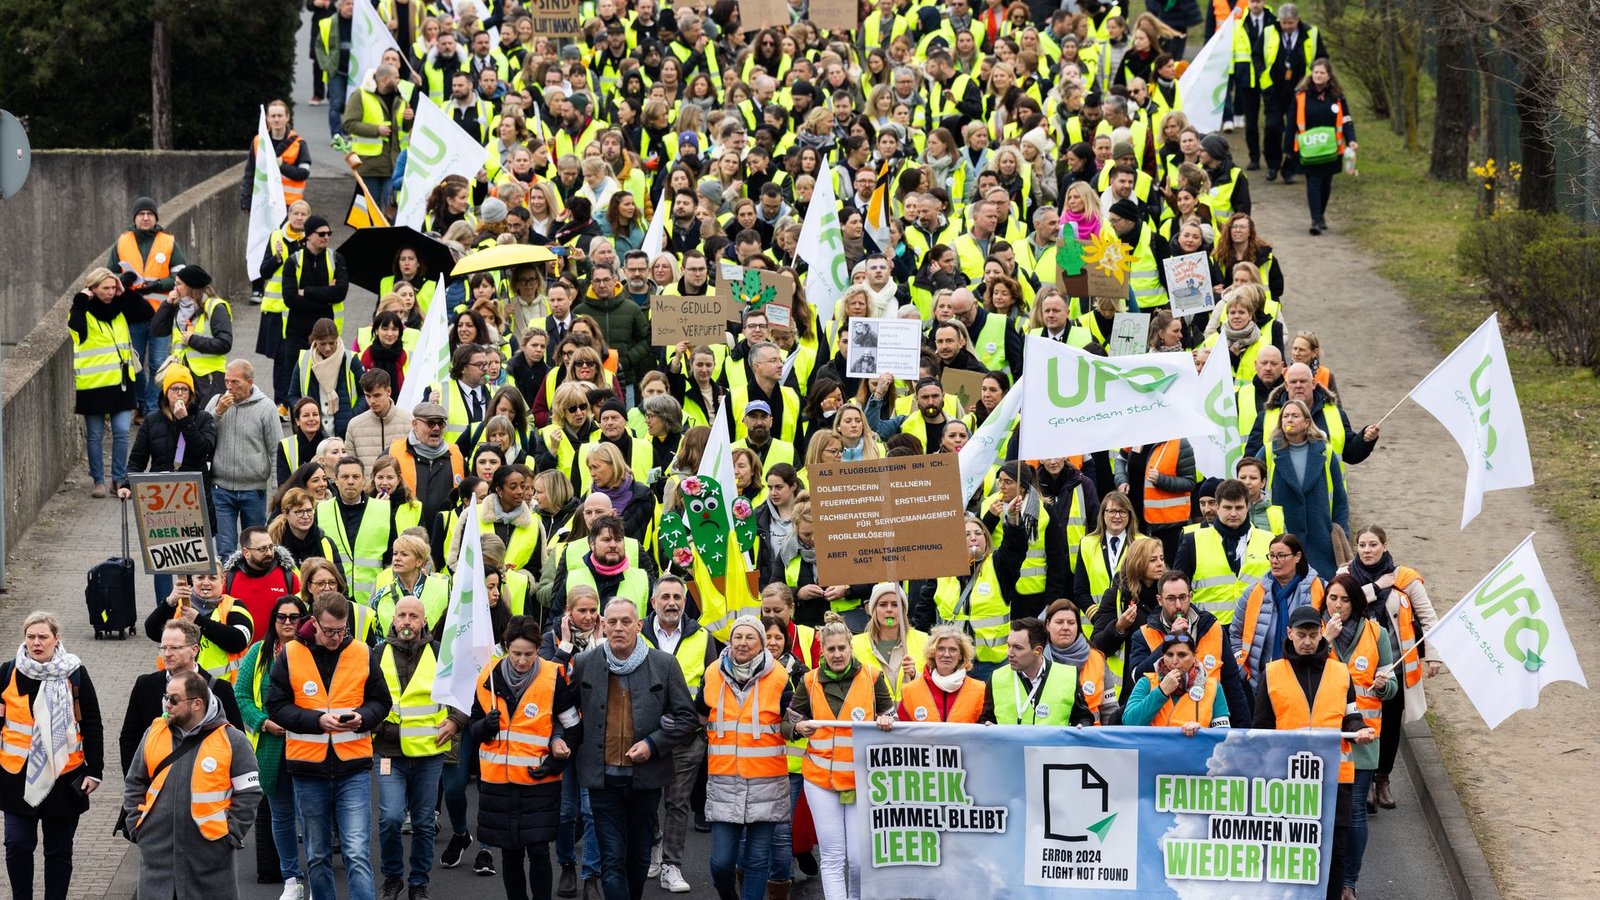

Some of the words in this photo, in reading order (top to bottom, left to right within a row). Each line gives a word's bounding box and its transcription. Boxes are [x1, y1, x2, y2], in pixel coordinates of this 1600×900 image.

[681, 301, 722, 314] GEDULD
[682, 323, 725, 337] VERPUFFT
[818, 468, 833, 477] ALS
[839, 463, 906, 476] FLUGBEGLEITERIN
[911, 462, 925, 470] BIN
[816, 483, 879, 493] DOLMETSCHERIN
[890, 480, 932, 488] KELLNERIN
[820, 495, 885, 507] FEUERWEHRFRAU
[895, 494, 950, 506] ERSTHELFERIN
[819, 511, 880, 521] FACHBERATERIN
[856, 519, 871, 528] FÜR
[875, 510, 957, 526] SERVICEMANAGEMENT
[149, 526, 180, 538] ABER
[828, 530, 896, 541] PROBLEMLÖSERIN
[150, 540, 208, 569] DANKE
[827, 551, 848, 559] ABER
[858, 543, 943, 556] GEHALTSABRECHNUNG
[870, 747, 930, 768] KABINE
[936, 748, 958, 768] IM
[1291, 755, 1320, 780] FÜR
[871, 770, 971, 805] STREIK,
[1159, 777, 1245, 812] FAIREN
[1254, 781, 1319, 816] LOHN
[873, 807, 942, 829] HIMMEL
[948, 808, 1005, 830] BLEIBT
[1211, 818, 1283, 842] KOMMEN
[1289, 822, 1318, 844] WIR
[874, 831, 937, 864] LEER
[1042, 848, 1073, 863] ERROR
[1075, 850, 1102, 863] 2024
[1166, 841, 1261, 878] WIEDER
[1271, 845, 1317, 881] HER
[1041, 865, 1074, 879] FLIGHT
[1076, 867, 1095, 880] NOT
[1098, 868, 1128, 881] FOUND
